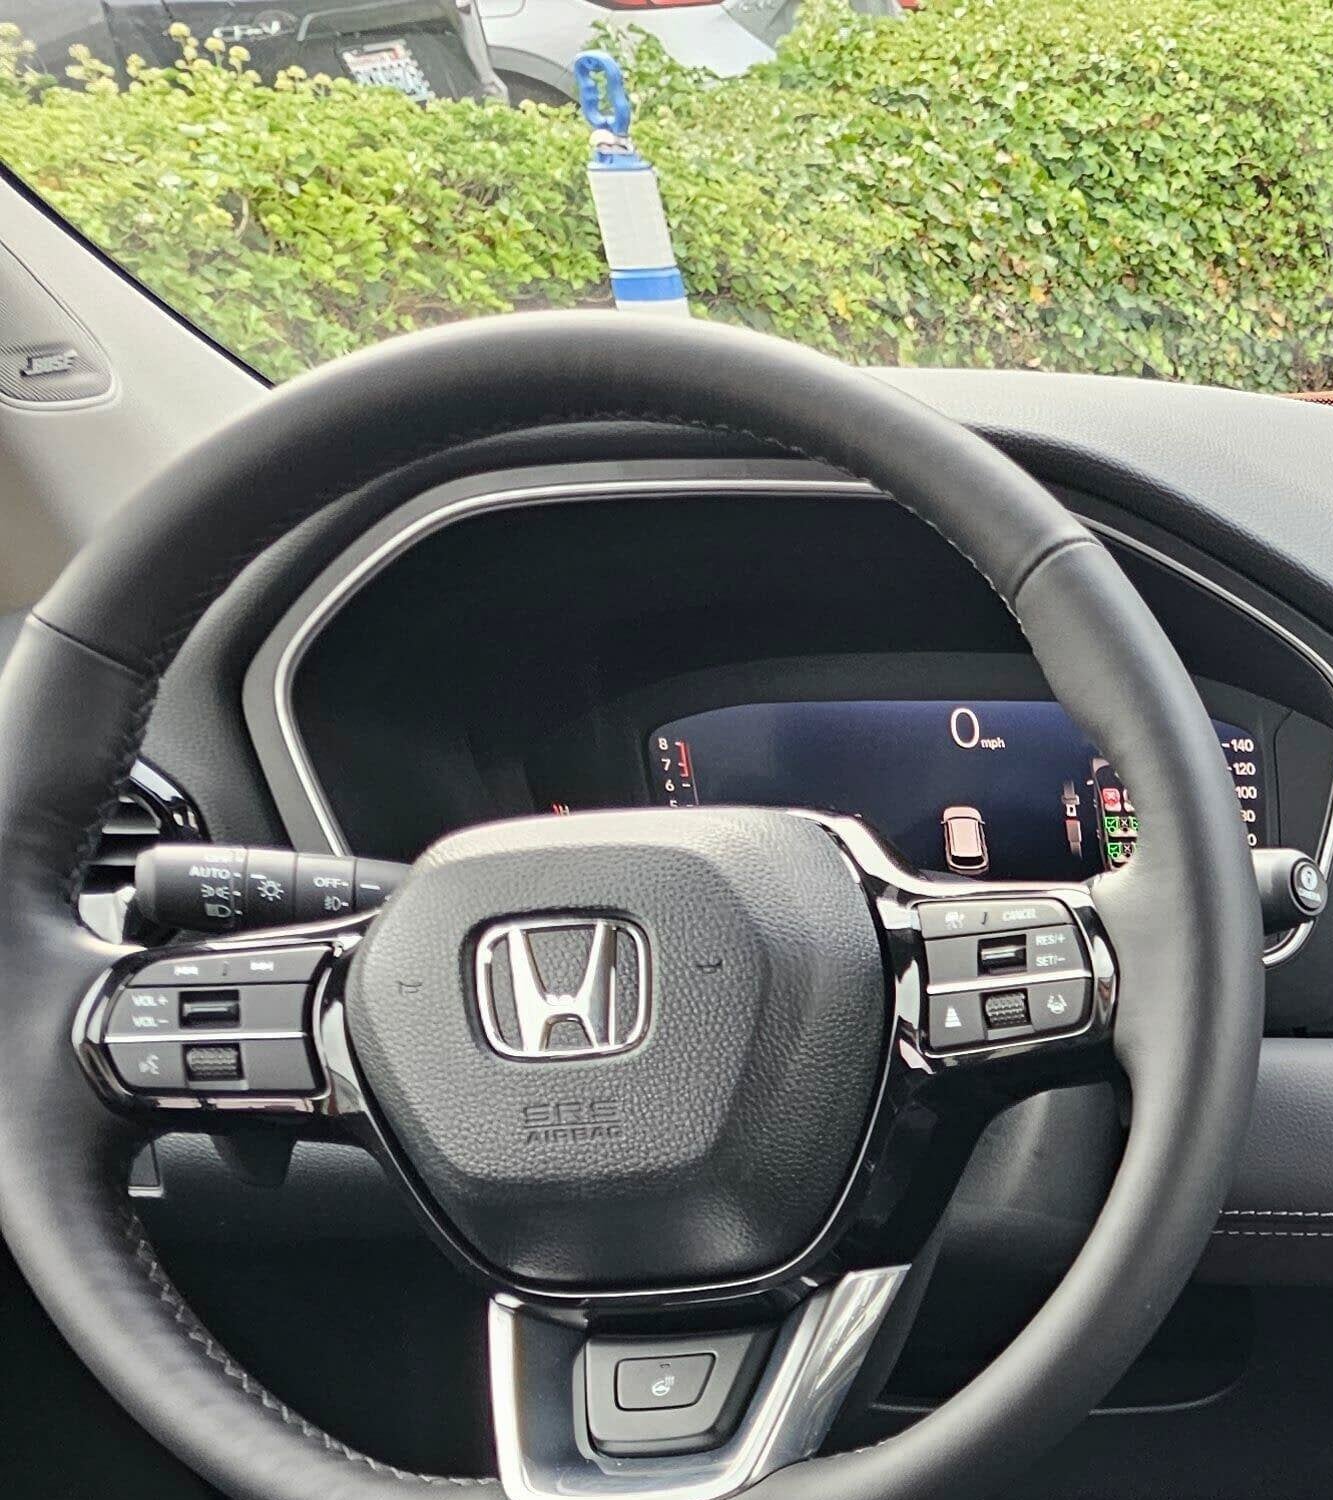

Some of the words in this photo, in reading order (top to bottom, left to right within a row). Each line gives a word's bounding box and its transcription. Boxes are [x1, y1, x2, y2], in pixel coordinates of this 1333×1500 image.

[951, 708, 980, 748] 0
[980, 736, 1006, 750] mph
[658, 738, 669, 750] 8
[1231, 739, 1254, 752] 140
[661, 758, 671, 771] 7
[1233, 762, 1256, 776] 120
[665, 779, 675, 791] 6
[1235, 786, 1257, 799] 100
[189, 865, 230, 880] AUTO
[313, 877, 342, 889] OFF
[523, 1100, 619, 1124] SRS
[526, 1126, 623, 1144] AIRBAG
